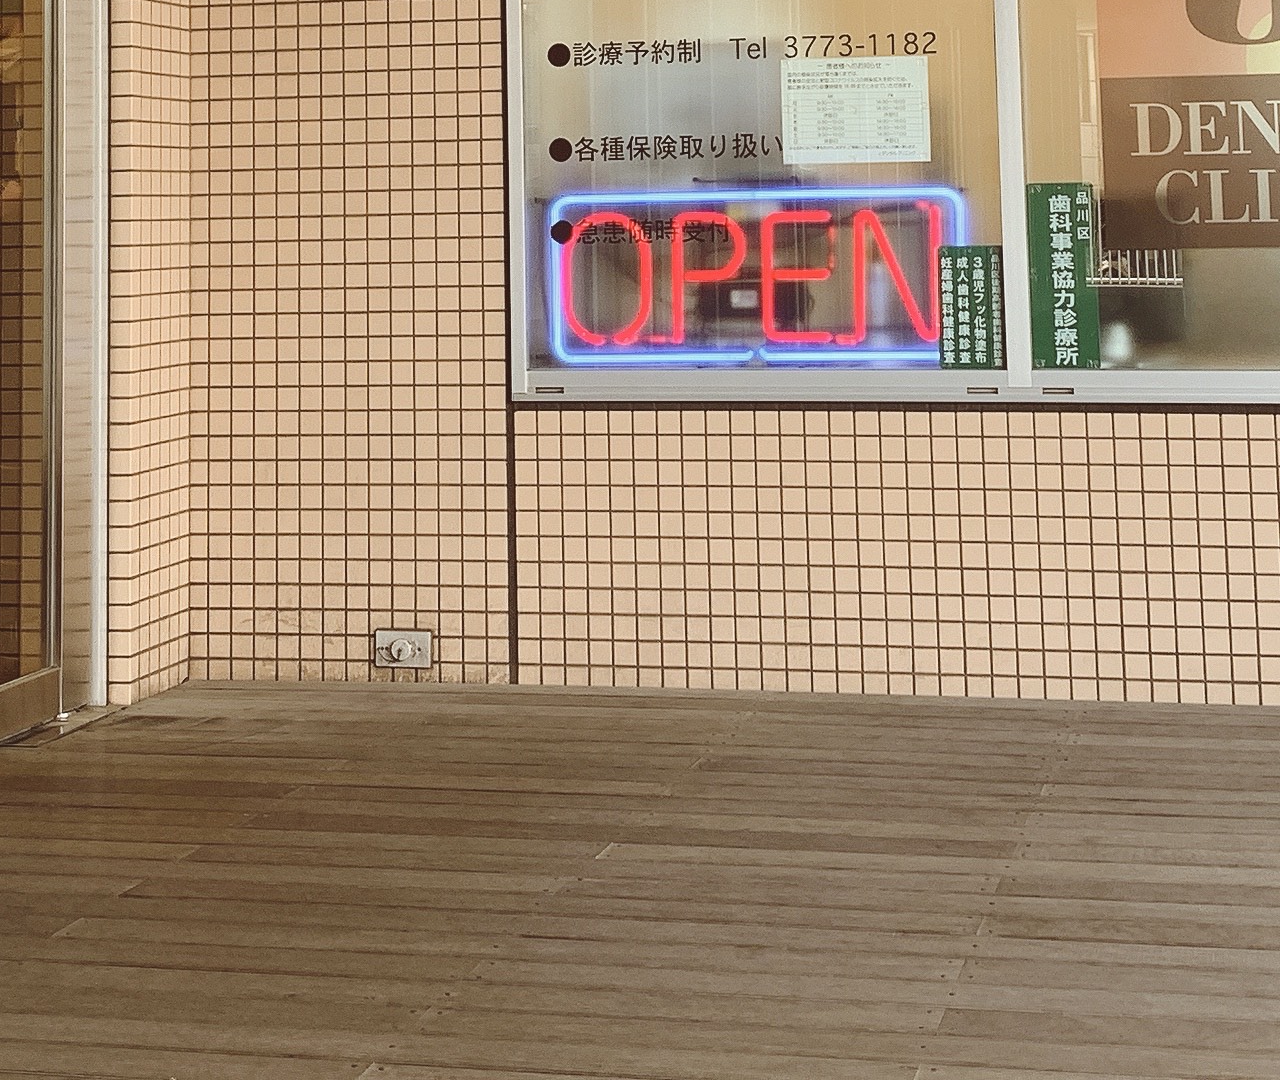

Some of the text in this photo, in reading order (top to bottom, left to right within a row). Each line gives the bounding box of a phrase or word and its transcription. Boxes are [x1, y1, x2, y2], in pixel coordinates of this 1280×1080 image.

[572, 31, 938, 67] 診療予約制 Tel 3773-1182
[1075, 191, 1092, 240] 品川区
[560, 201, 944, 346] OPEN
[1047, 194, 1080, 366] 歯科事業協力診療所
